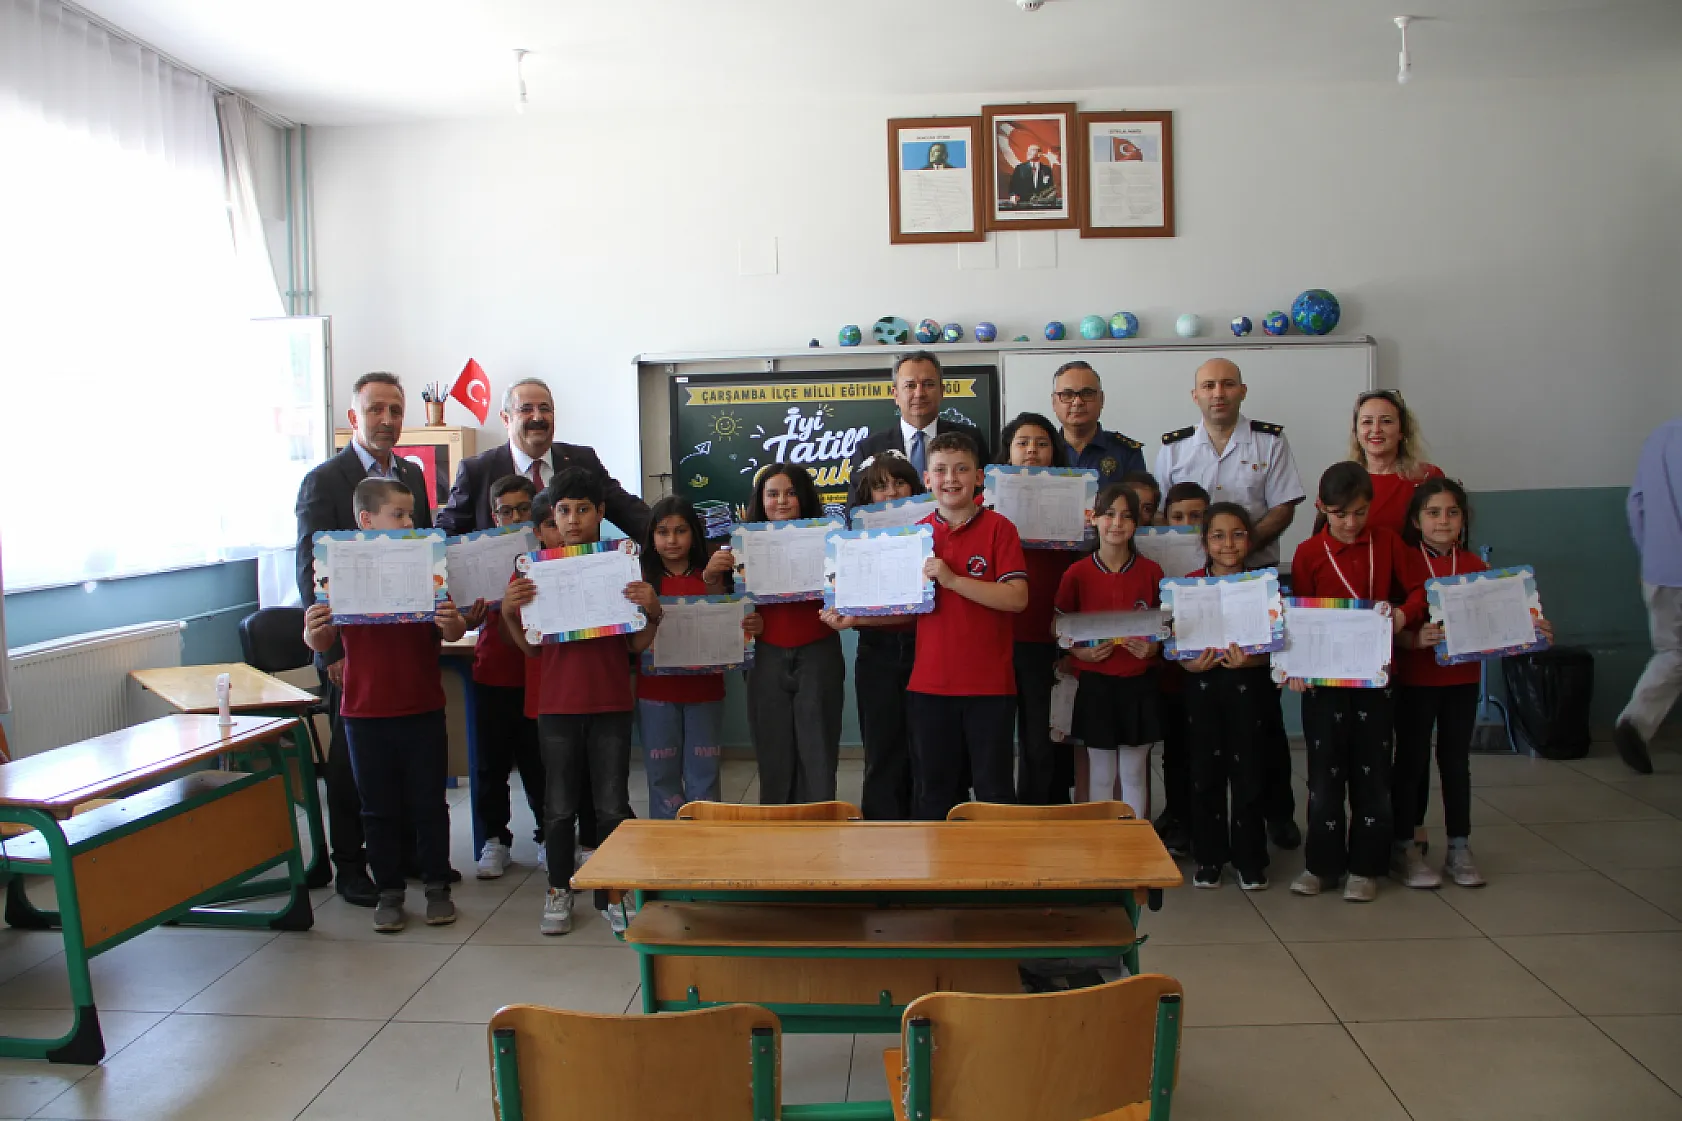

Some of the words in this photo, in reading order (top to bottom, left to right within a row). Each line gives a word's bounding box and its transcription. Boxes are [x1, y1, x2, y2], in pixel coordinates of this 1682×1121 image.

[702, 389, 766, 404] ÇARŞAMBA
[772, 386, 798, 402] İLÇE
[803, 384, 836, 398] MİLLİ
[841, 383, 882, 397] EĞİTİM
